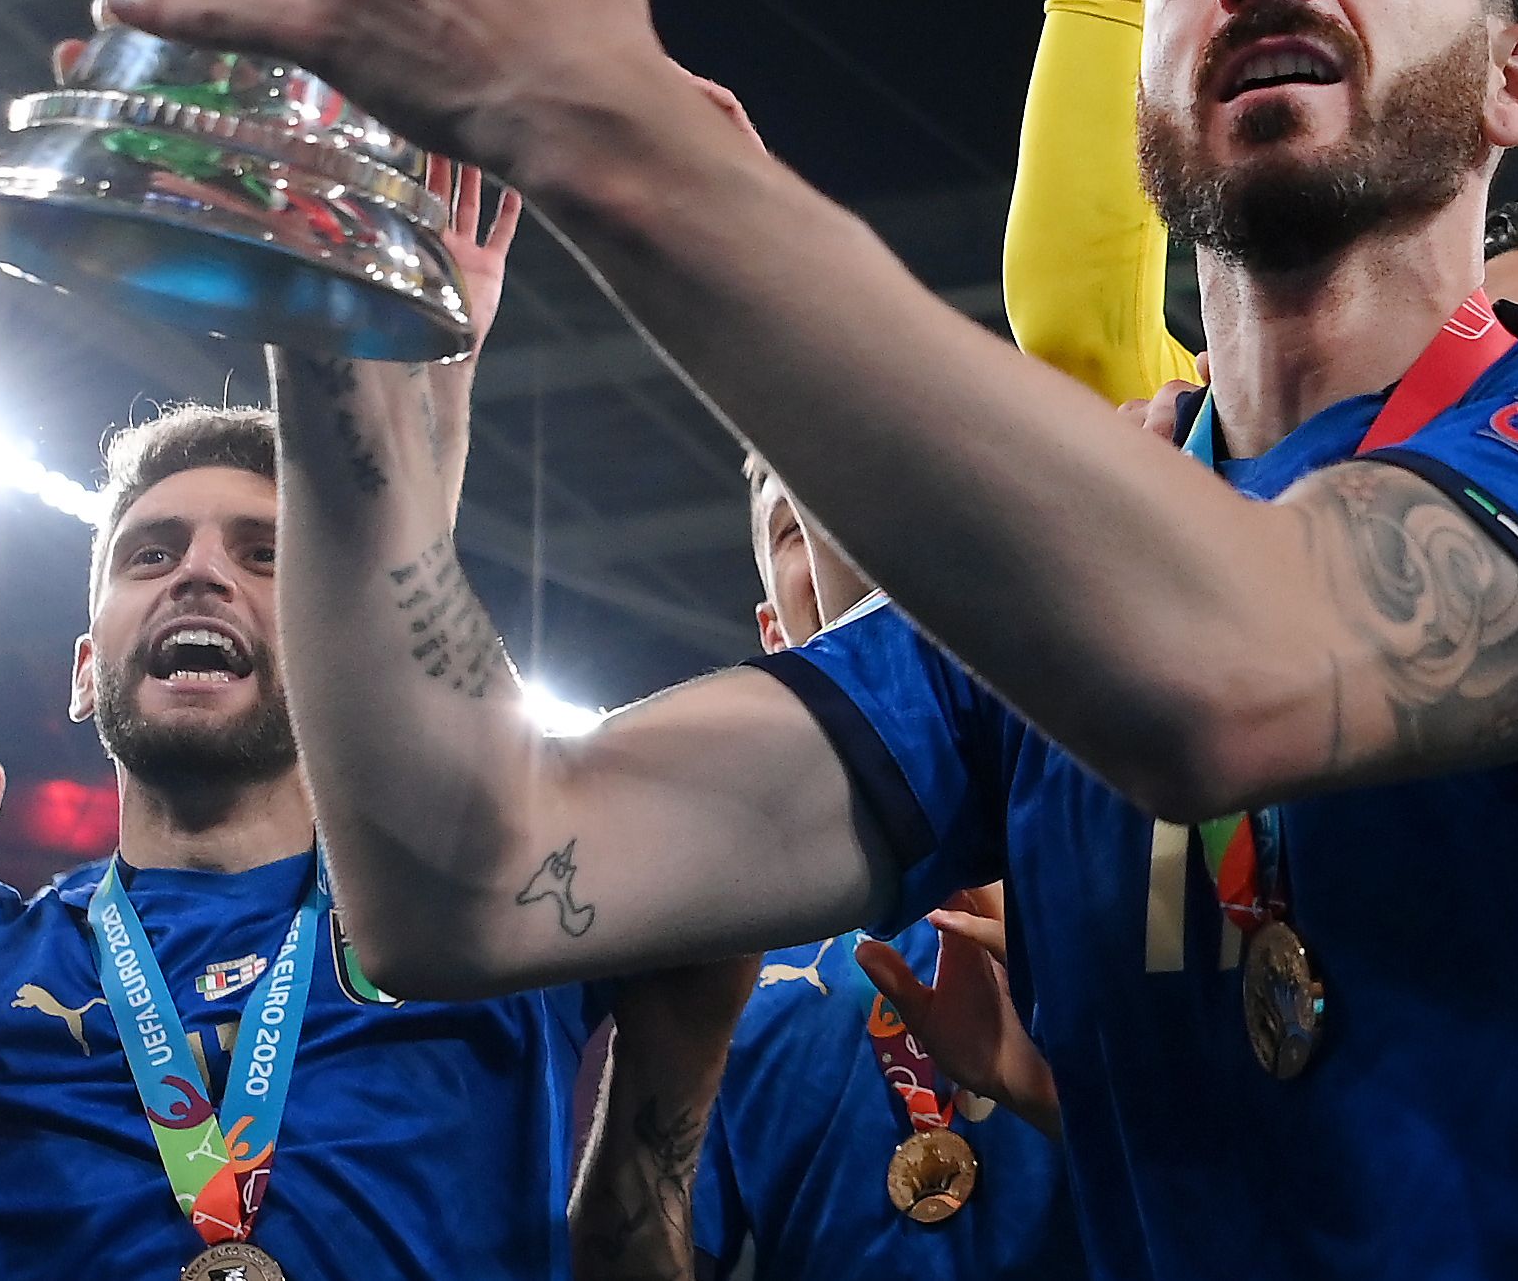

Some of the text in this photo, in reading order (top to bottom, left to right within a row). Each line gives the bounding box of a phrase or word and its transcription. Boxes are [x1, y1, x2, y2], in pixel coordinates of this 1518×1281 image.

[101, 902, 173, 1067] UEFA EURO 2020
[260, 958, 295, 1026] EURO
